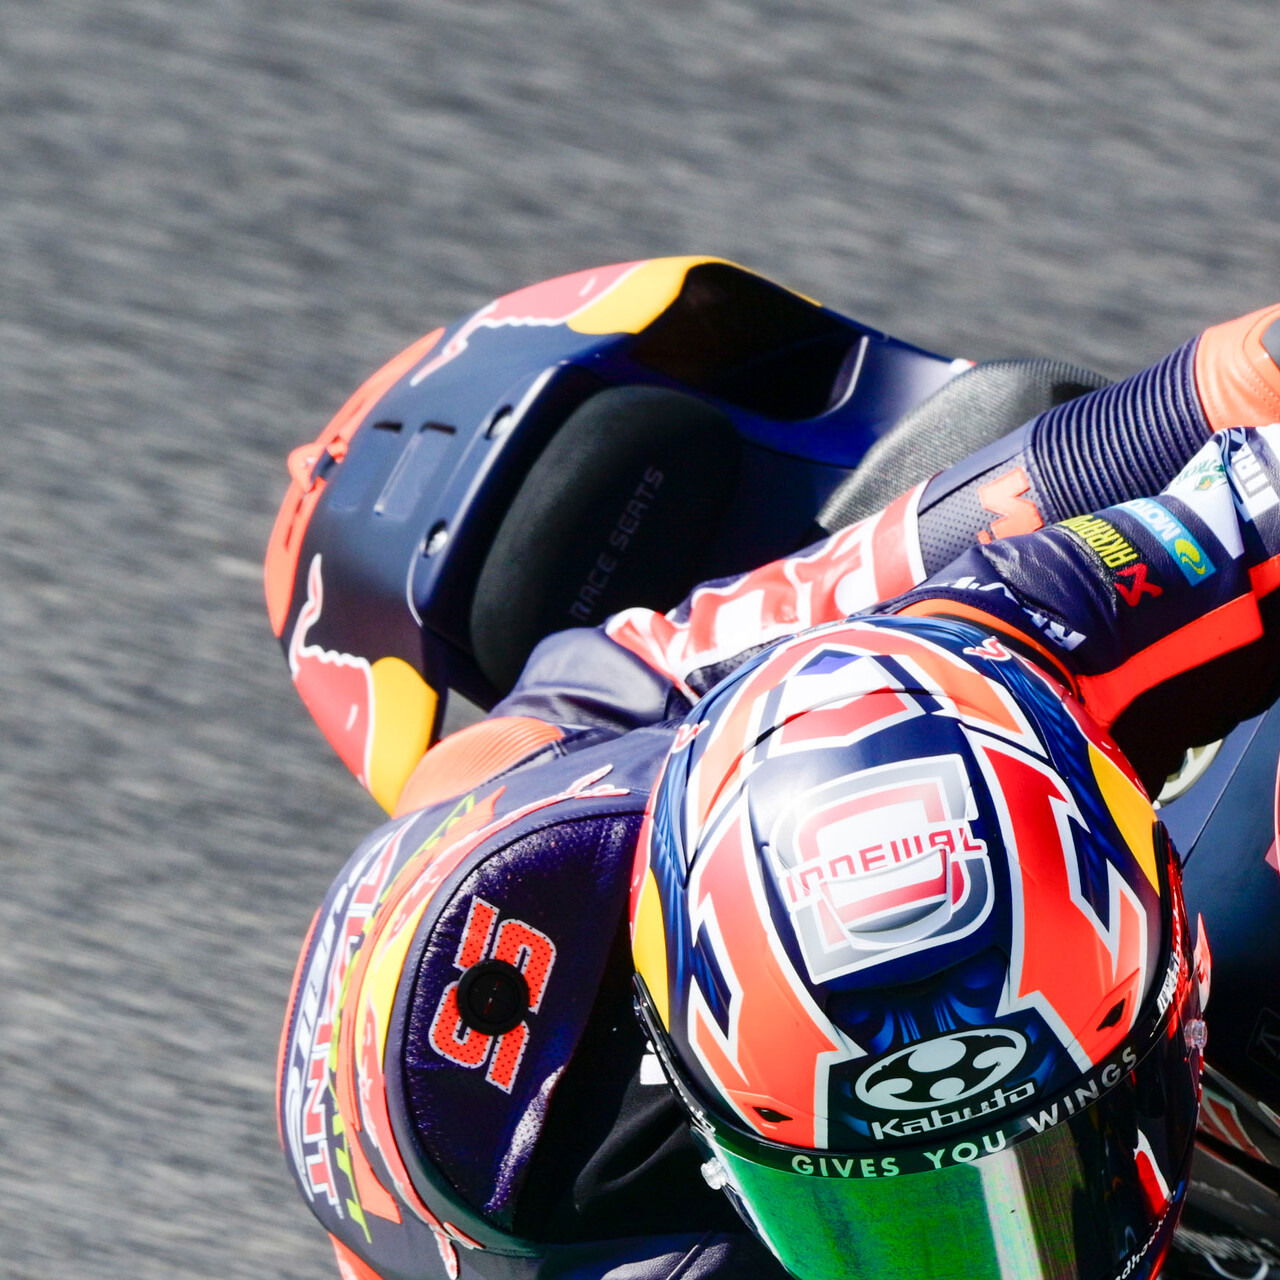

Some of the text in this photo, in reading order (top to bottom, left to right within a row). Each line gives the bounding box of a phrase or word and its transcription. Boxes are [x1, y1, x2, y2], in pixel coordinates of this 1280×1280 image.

[791, 1046, 1139, 1180] GIVES YOU WINGS
[872, 1081, 1036, 1141] Kabuto
